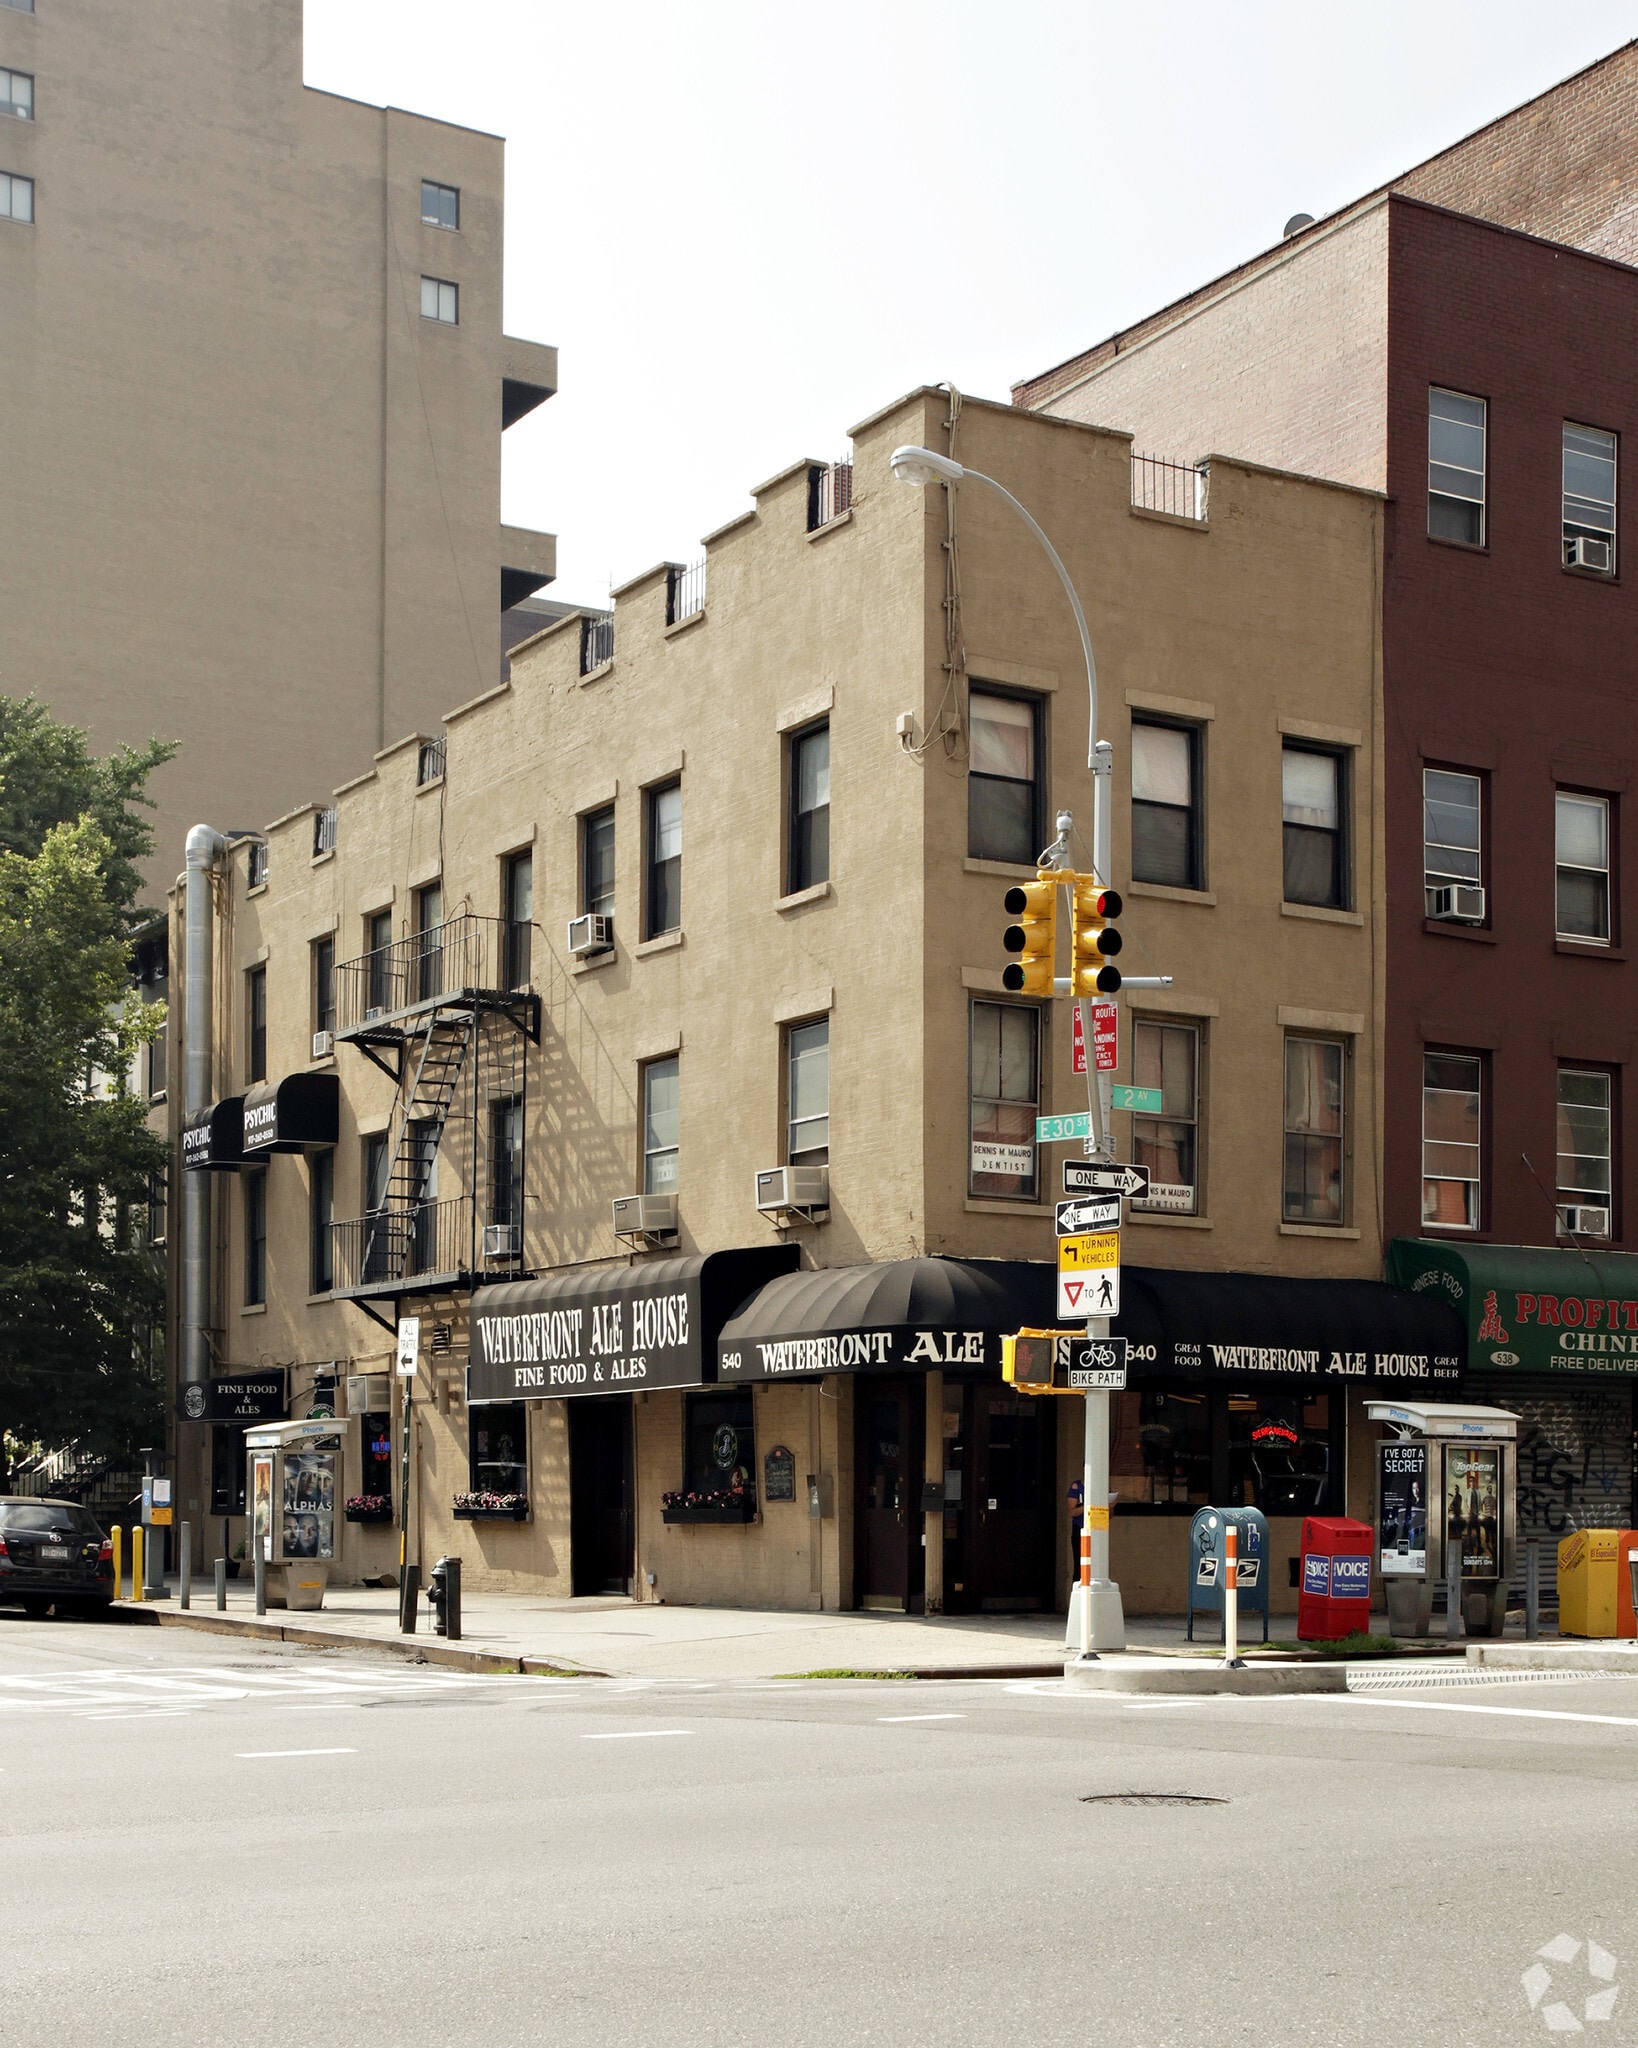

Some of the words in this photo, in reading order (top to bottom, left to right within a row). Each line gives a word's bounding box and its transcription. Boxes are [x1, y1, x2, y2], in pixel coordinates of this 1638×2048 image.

[1096, 1007, 1115, 1018] ROUTE
[1124, 1089, 1134, 1107] 2
[1137, 1090, 1148, 1100] AV
[244, 1101, 276, 1130] PSYCHIC
[1041, 1120, 1050, 1138] E
[1053, 1117, 1074, 1137] 30
[1077, 1116, 1087, 1127] ST
[183, 1125, 212, 1150] PSYCHIC
[974, 1145, 996, 1155] DENNIS
[1008, 1148, 1031, 1158] MAURO
[982, 1160, 1025, 1171] DENTIST
[1075, 1172, 1099, 1185] ONE
[1113, 1174, 1137, 1188] WAY
[1168, 1188, 1190, 1198] MAURO
[1064, 1210, 1082, 1225] ONE
[1092, 1205, 1111, 1220] WAY
[1081, 1238, 1116, 1250] TURNING
[1081, 1252, 1115, 1264] VEHICLES
[1442, 1272, 1464, 1298] FOOD
[1084, 1289, 1094, 1298] TO
[477, 1308, 583, 1364] WATERFRONT
[590, 1301, 623, 1355] ALE
[632, 1293, 689, 1351] HOUSE
[756, 1332, 892, 1373] WATERFRONT
[903, 1331, 985, 1363] ALE
[1126, 1345, 1156, 1361] 540
[1174, 1343, 1201, 1353] GREAT
[721, 1352, 742, 1369] 540
[1174, 1356, 1202, 1366] FOOD
[1207, 1344, 1319, 1373] WATERFRONT
[1325, 1352, 1367, 1376] ALE
[1374, 1353, 1429, 1377] HOUSE
[1434, 1356, 1459, 1367] GREAT
[1497, 1353, 1513, 1364] 538
[1550, 1355, 1585, 1369] FREE
[514, 1366, 544, 1387] FINE
[549, 1363, 587, 1385] FOOD
[593, 1361, 604, 1382] &
[610, 1356, 647, 1380] ALES
[1433, 1369, 1459, 1379] BEER
[1072, 1372, 1094, 1385] BIKE
[1098, 1372, 1122, 1384] PATH
[217, 1385, 244, 1394] FINE
[246, 1385, 277, 1394] FOOD
[243, 1395, 252, 1404] &
[234, 1405, 261, 1414] ALES
[1390, 1408, 1409, 1420] Phone
[302, 1426, 324, 1434] Phone
[1462, 1423, 1484, 1433] Phone
[1384, 1448, 1399, 1458] I'VE
[1401, 1448, 1417, 1458] GOT
[1418, 1448, 1424, 1458] A
[1385, 1459, 1424, 1472] SECRET
[284, 1501, 333, 1511] ALPHAS
[1335, 1562, 1369, 1577] VOICE
